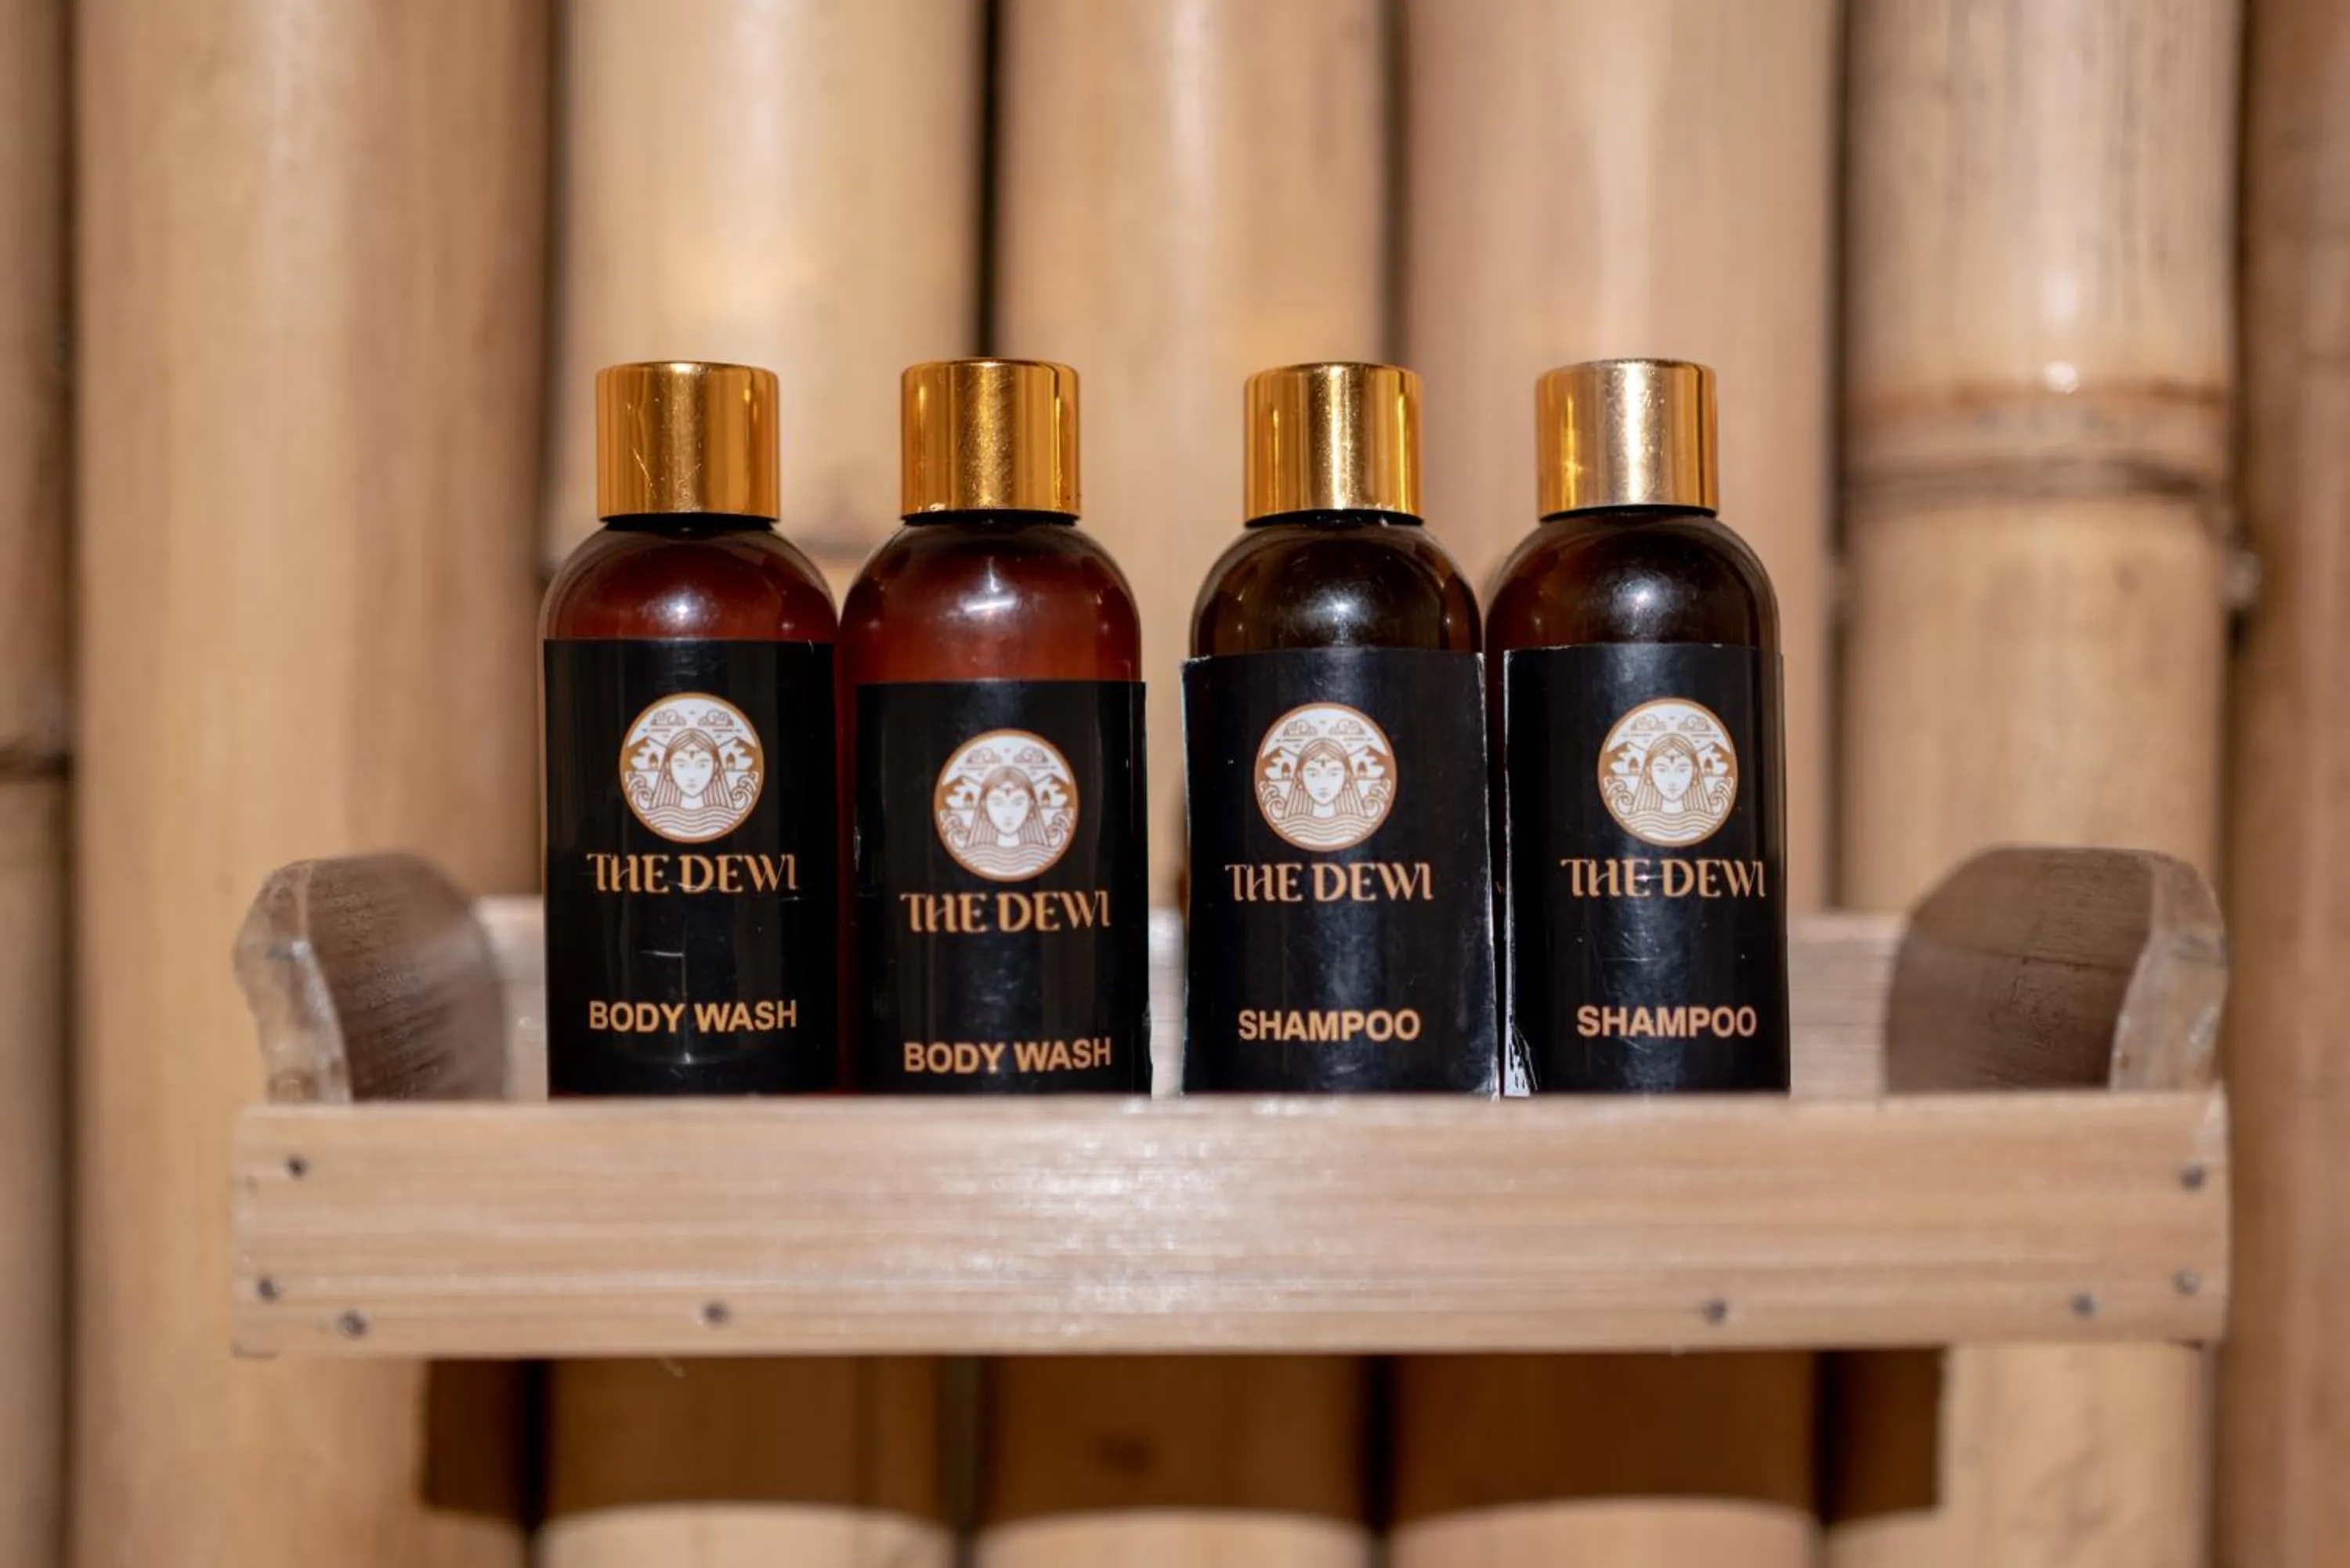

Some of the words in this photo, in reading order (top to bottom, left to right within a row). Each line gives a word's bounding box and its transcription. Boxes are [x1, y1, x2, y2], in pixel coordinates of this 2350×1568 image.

[588, 854, 669, 893] THE
[678, 854, 797, 893] DEWI
[1224, 863, 1302, 901] THE
[1314, 862, 1432, 901] DEWI
[1560, 858, 1650, 897] THE
[1662, 858, 1767, 897] DEWI
[900, 893, 987, 933] THE
[996, 891, 1111, 932] DEWI
[590, 1001, 685, 1033] BODY
[694, 999, 796, 1032] WASH
[1239, 1009, 1420, 1042] SHAMPOO
[1578, 1006, 1756, 1037] SHAMPOO
[905, 1042, 1003, 1073] BODY
[1014, 1039, 1110, 1071] WASH
